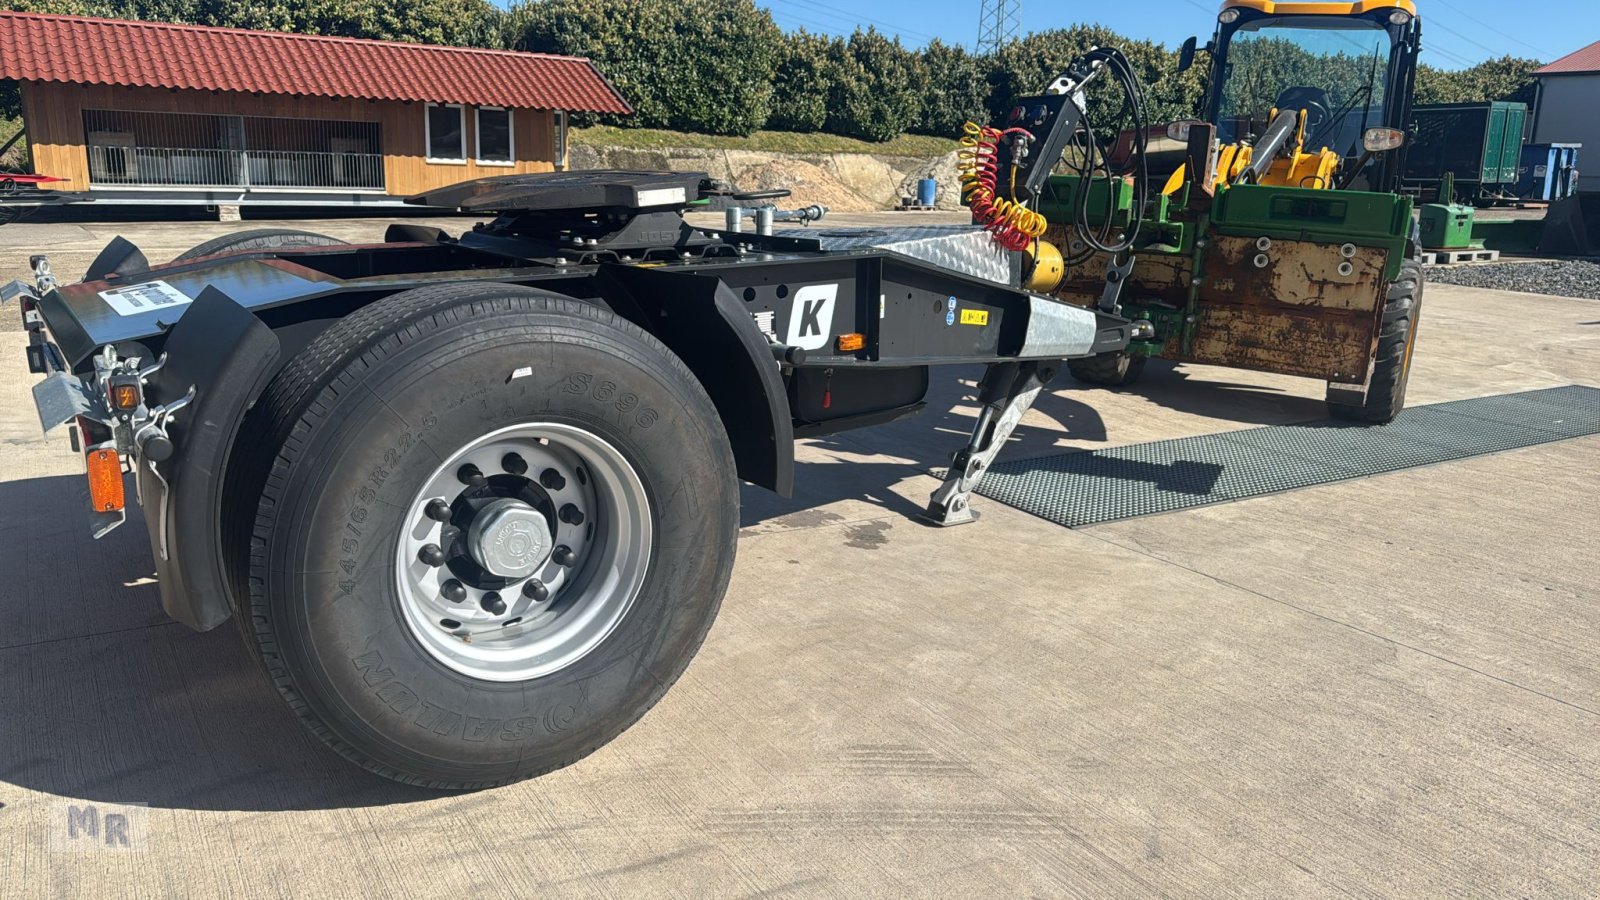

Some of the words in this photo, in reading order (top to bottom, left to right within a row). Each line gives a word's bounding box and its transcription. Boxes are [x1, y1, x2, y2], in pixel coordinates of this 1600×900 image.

[798, 299, 827, 337] K
[562, 371, 659, 429] S696
[338, 411, 438, 595] 445/65R22.5
[351, 650, 538, 743] SAILUN
